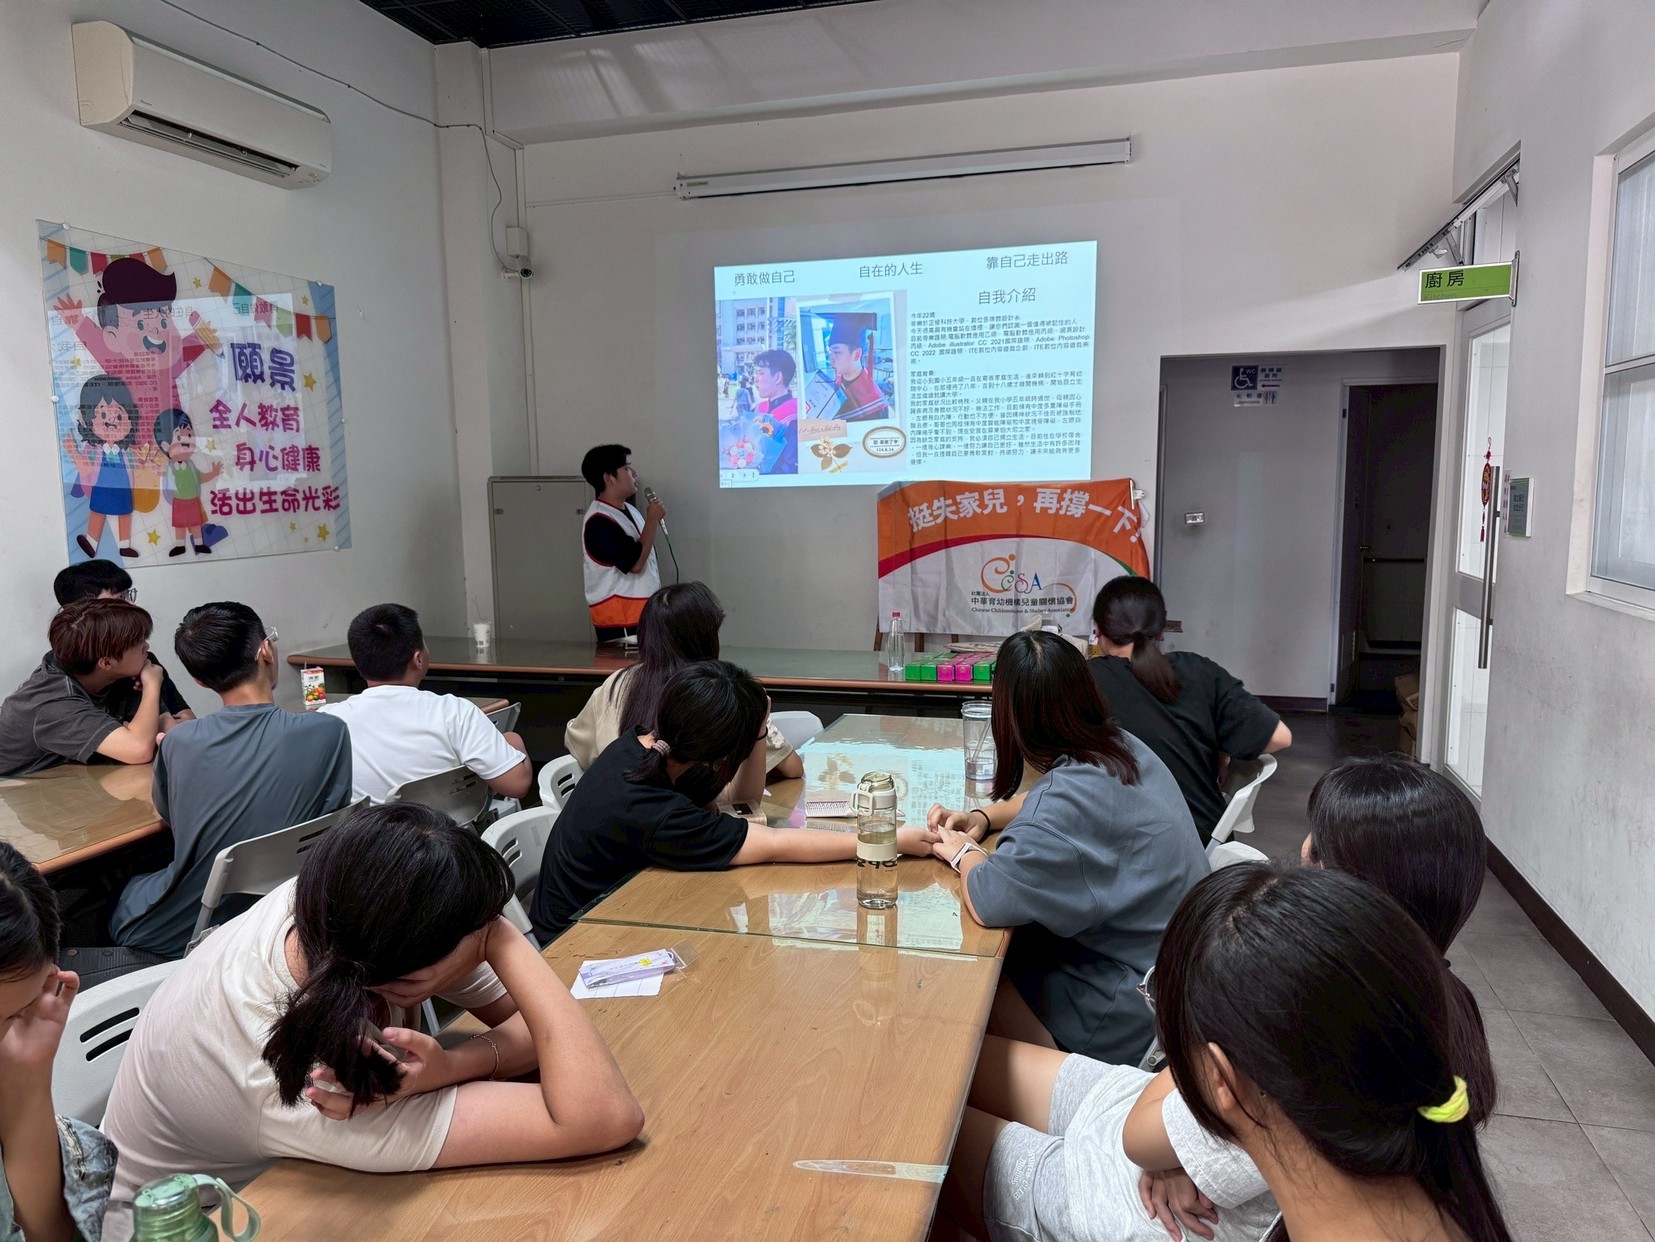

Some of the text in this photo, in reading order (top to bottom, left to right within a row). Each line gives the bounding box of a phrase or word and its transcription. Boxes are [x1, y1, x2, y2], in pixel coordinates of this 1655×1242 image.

[859, 261, 923, 278] 自在的人生
[986, 251, 1068, 270] 靠自己走出路
[734, 270, 796, 286] 勇敢做自己
[1425, 270, 1465, 289] 廚房
[978, 288, 1036, 305] 自我介紹
[1058, 334, 1090, 342] Photoshop
[230, 342, 296, 392] 願景
[209, 399, 301, 433] 全人教育
[235, 442, 321, 472] 身心健康
[210, 485, 340, 516] 活出生命光彩
[971, 596, 1074, 606] 中華育幼機構兒童關懷協會
